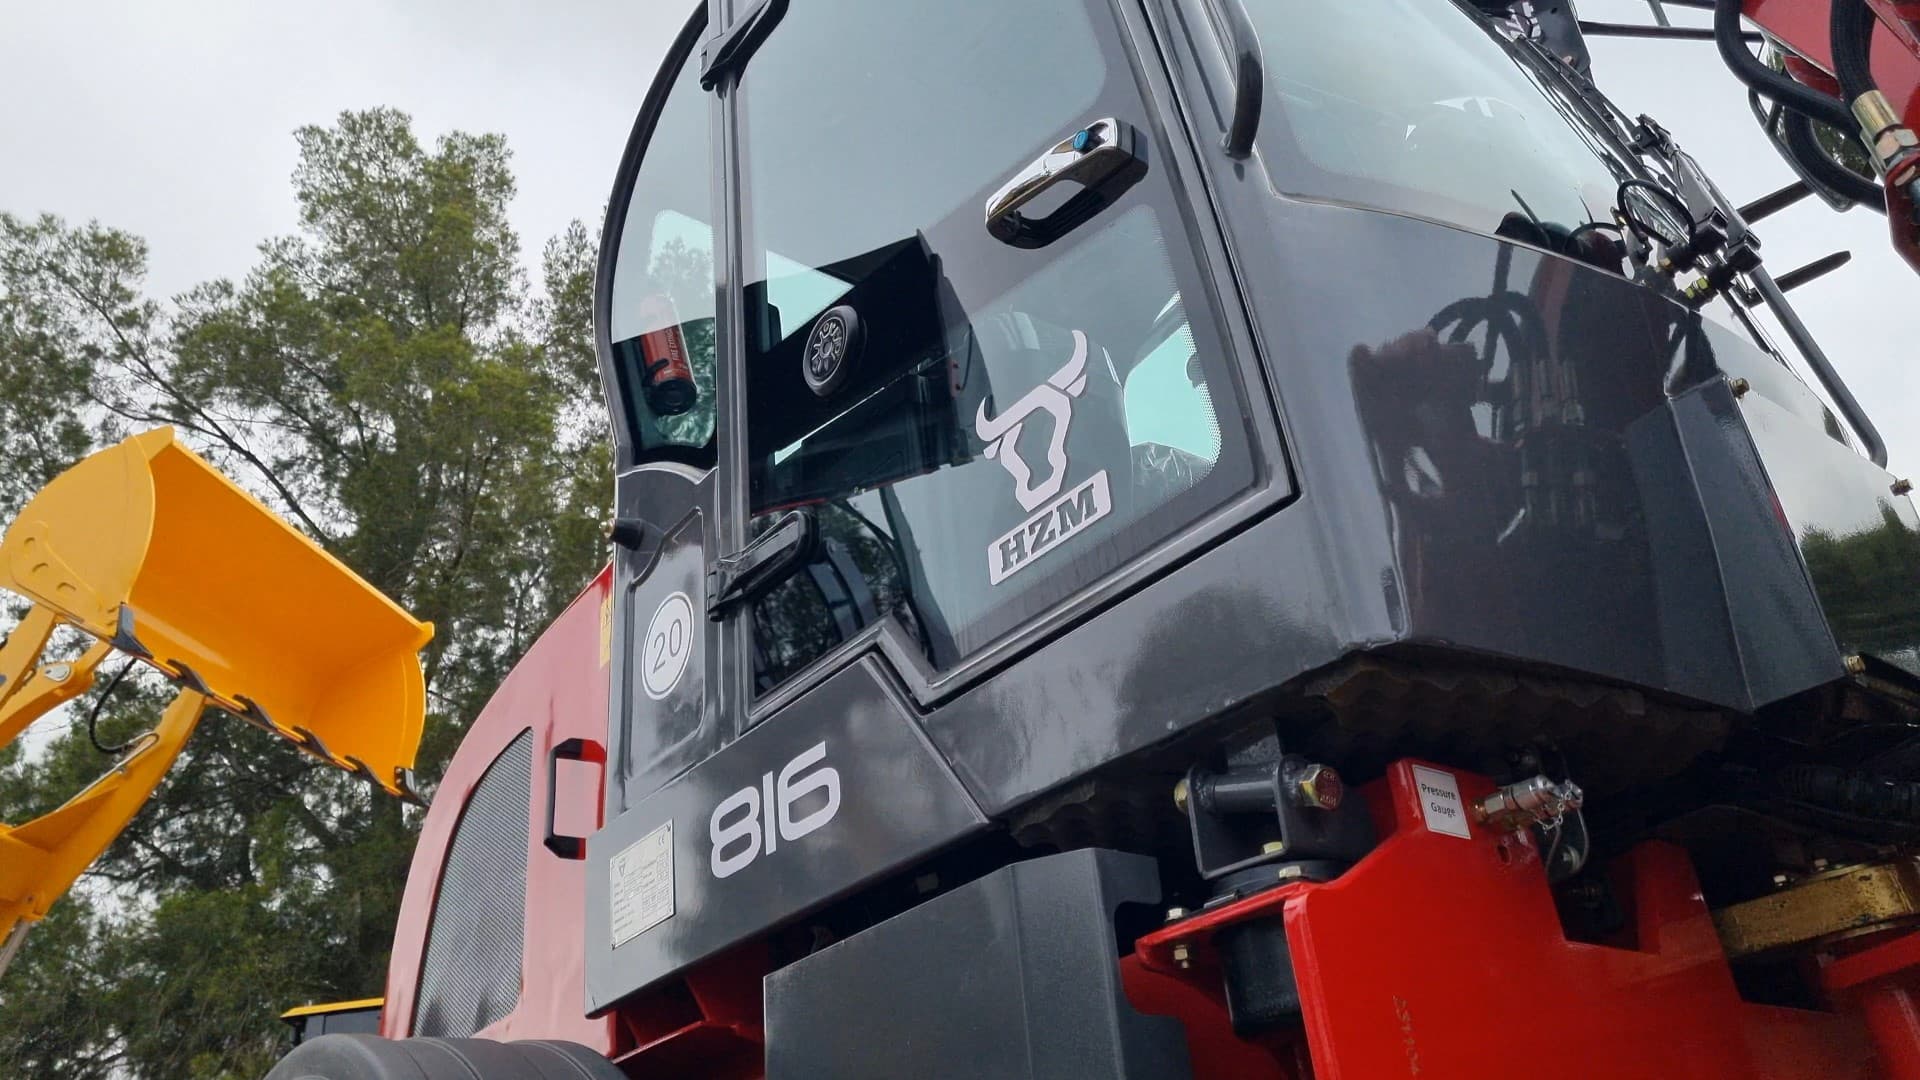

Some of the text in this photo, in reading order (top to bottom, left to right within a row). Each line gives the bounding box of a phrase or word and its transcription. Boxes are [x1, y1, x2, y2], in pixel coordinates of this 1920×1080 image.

[999, 483, 1098, 574] HZM
[653, 618, 682, 674] 20
[710, 740, 841, 879] 816
[1421, 783, 1456, 801] Pressure
[1430, 801, 1456, 818] Gauge
